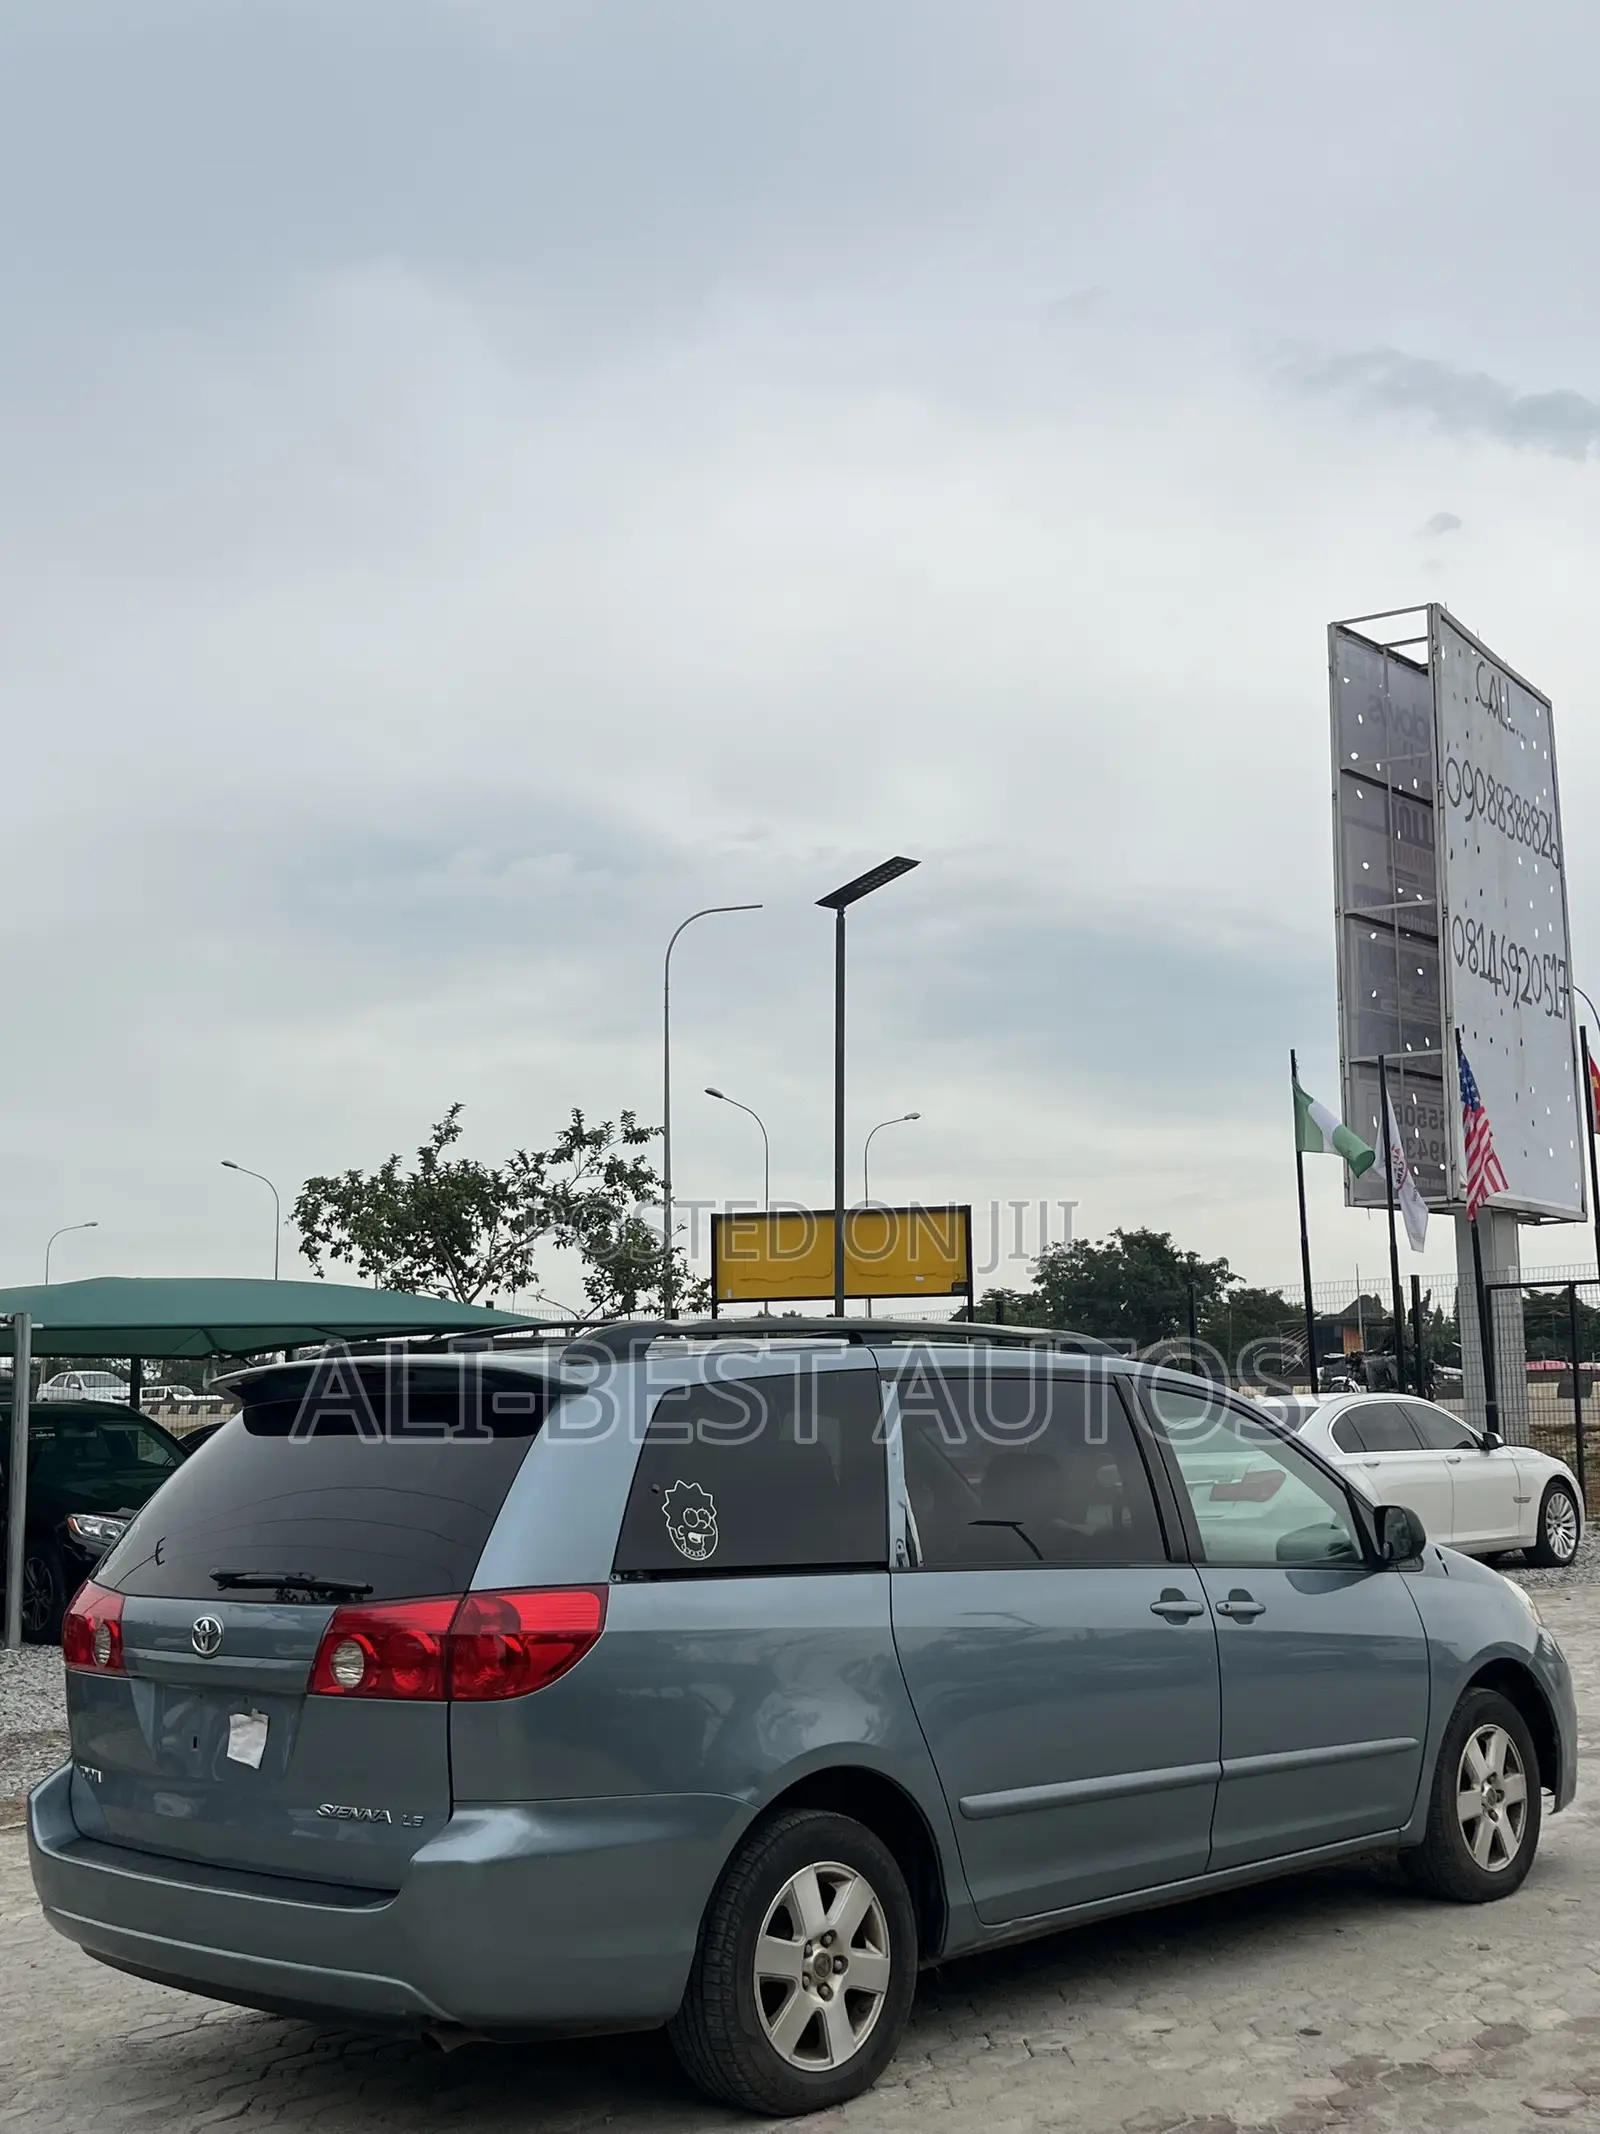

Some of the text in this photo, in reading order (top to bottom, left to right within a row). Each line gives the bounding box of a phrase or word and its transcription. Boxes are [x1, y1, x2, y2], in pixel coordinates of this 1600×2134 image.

[1446, 757, 1560, 869] 09088388826
[1452, 915, 1569, 1020] 08146920517
[316, 1803, 424, 1827] SIENNA LE
